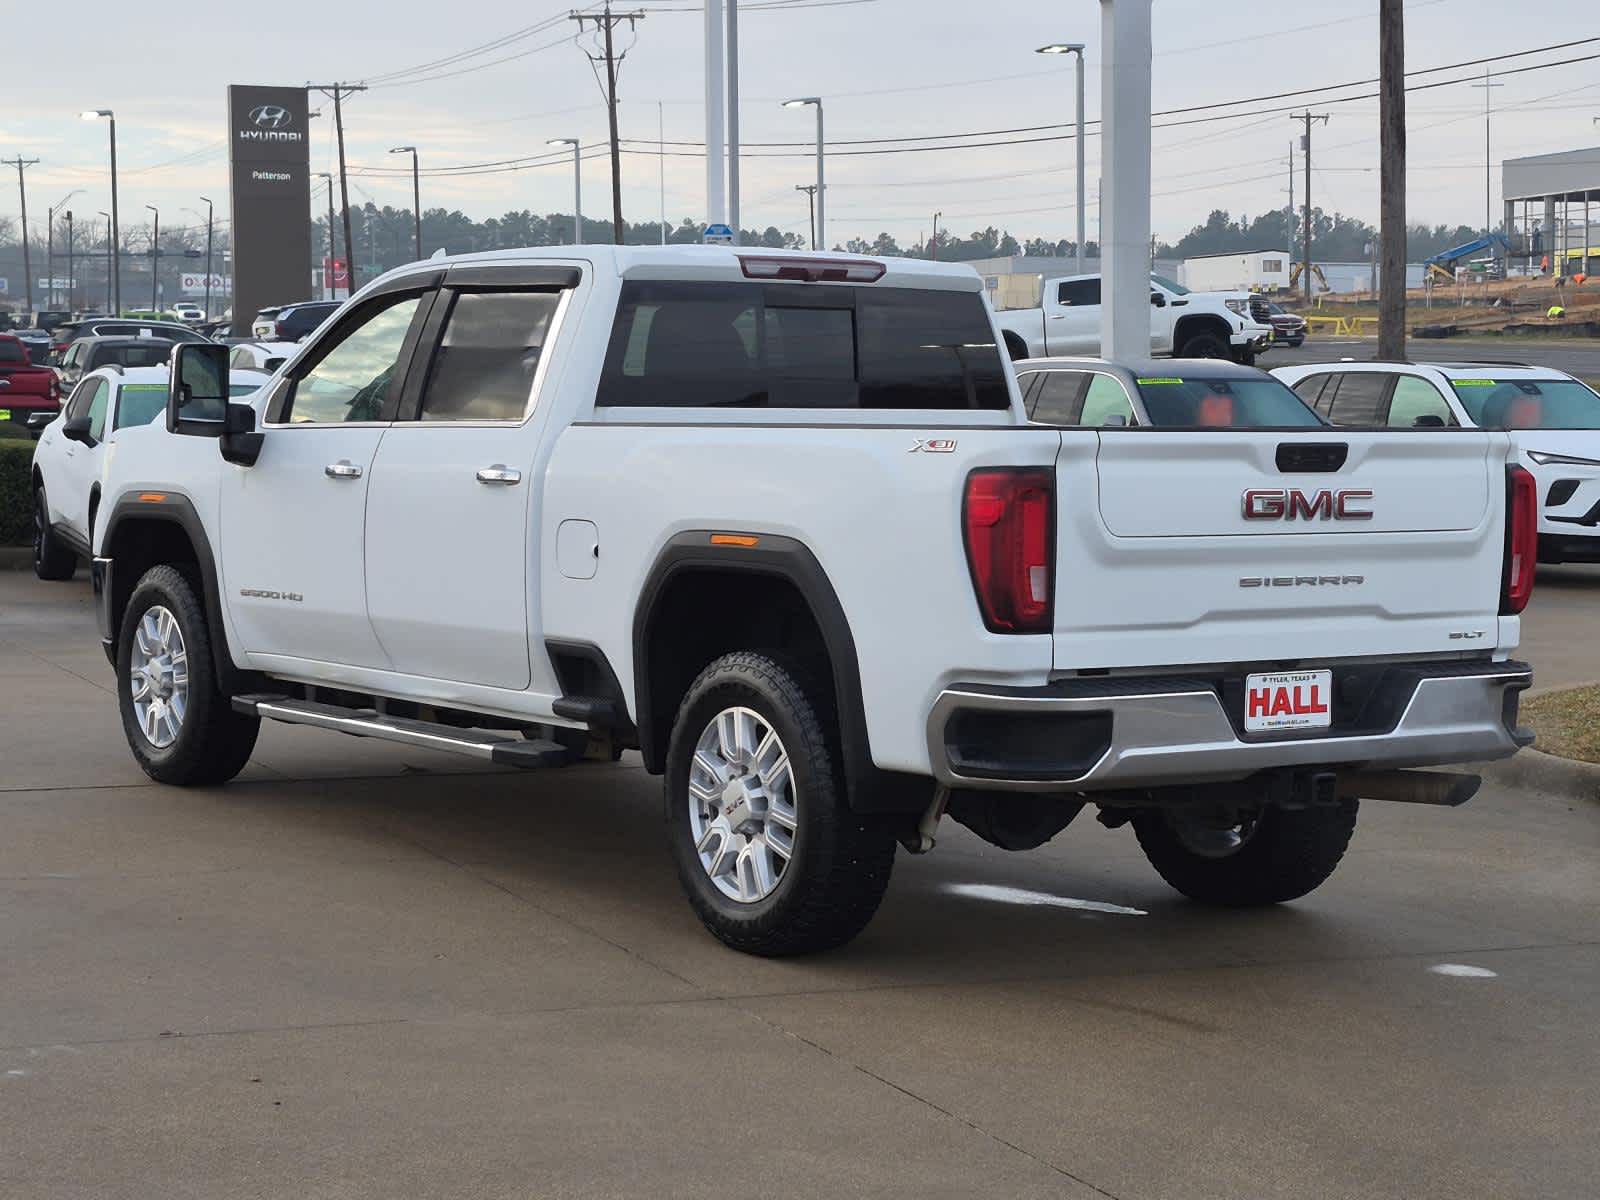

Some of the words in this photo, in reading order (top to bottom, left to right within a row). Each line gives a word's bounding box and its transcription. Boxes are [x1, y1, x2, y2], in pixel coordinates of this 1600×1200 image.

[240, 131, 302, 141] HYUNDAI
[252, 171, 291, 181] Patterson
[1241, 487, 1374, 521] GMC
[1239, 576, 1364, 588] SIERRA
[1448, 630, 1486, 639] SLT
[1248, 685, 1327, 717] HALL
